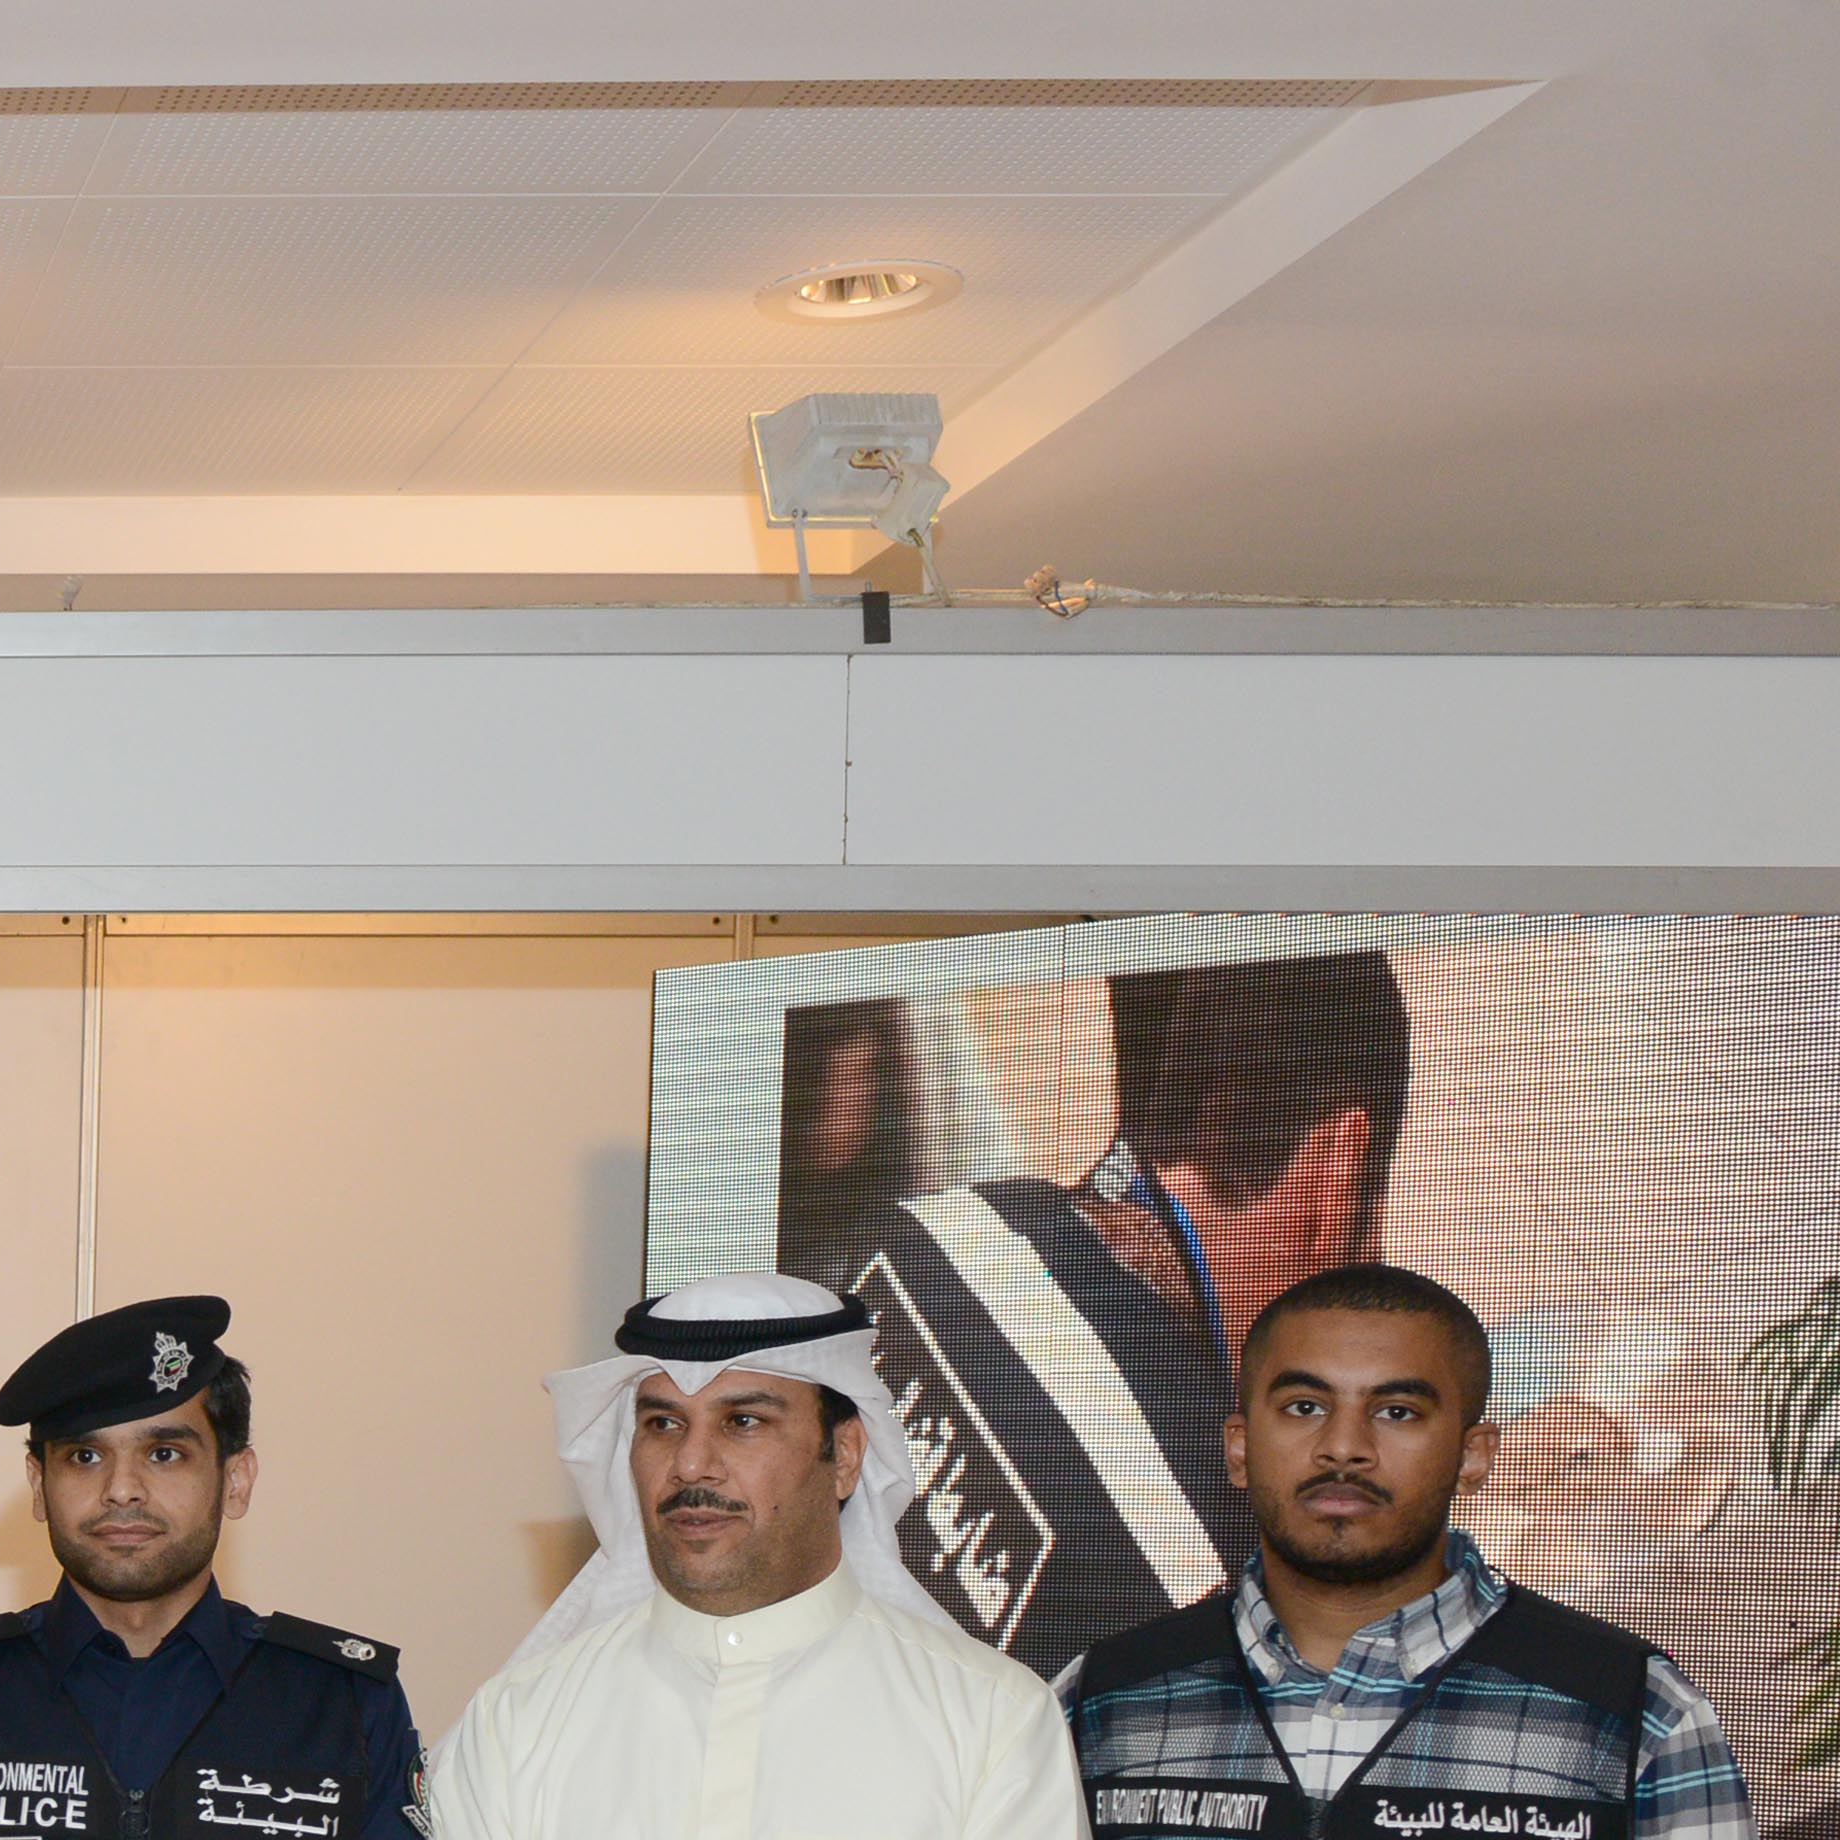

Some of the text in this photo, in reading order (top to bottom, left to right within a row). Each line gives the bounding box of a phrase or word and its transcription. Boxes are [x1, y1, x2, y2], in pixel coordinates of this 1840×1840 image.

[196, 1768, 341, 1805] شرطة
[196, 1800, 340, 1838] البيئة
[1157, 1788, 1198, 1826] PUBLIC
[1196, 1791, 1268, 1831] AUTHORITY
[1374, 1799, 1446, 1838] للبيئة
[1450, 1801, 1519, 1834] العامة
